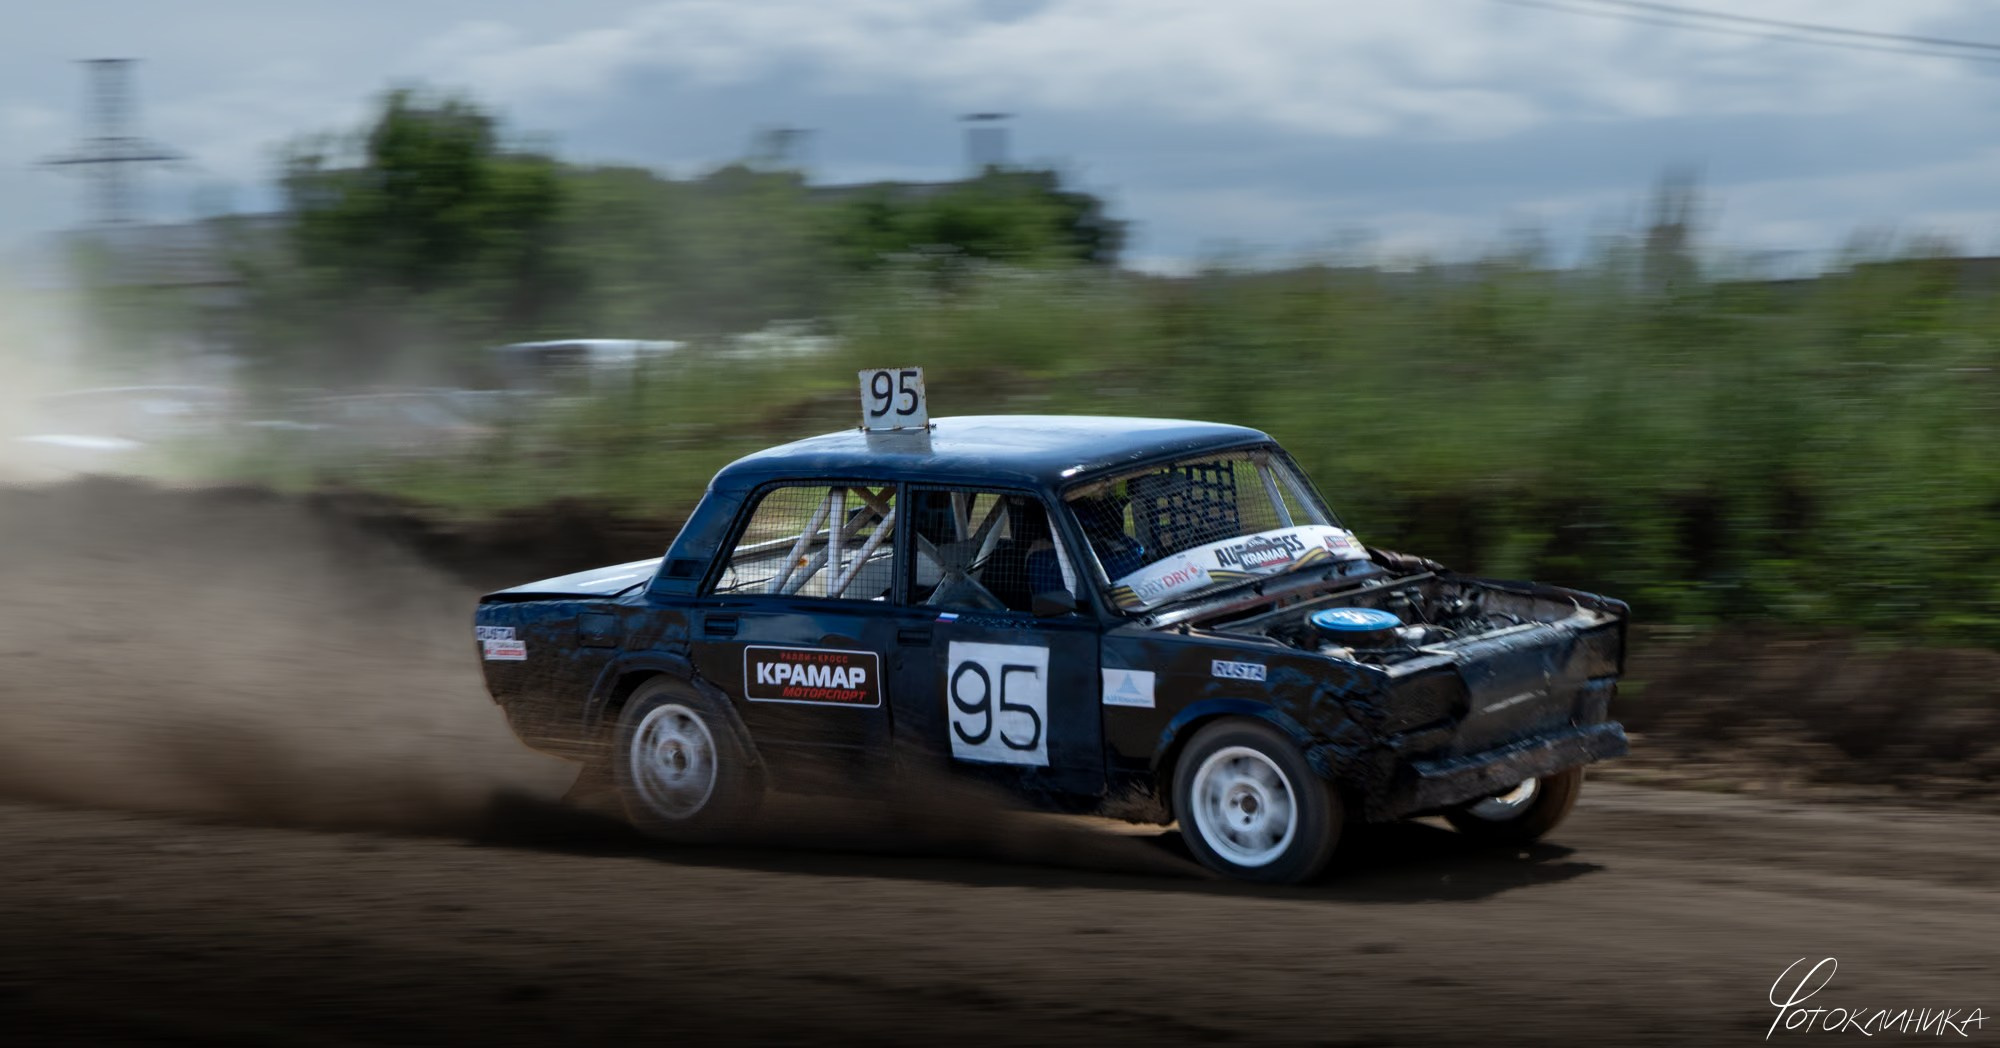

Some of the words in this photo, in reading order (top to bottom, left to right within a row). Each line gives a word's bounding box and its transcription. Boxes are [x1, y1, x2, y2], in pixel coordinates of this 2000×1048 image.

[870, 371, 919, 417] 95
[1240, 546, 1290, 568] KRAMAR
[756, 661, 866, 690] КРАМАР
[1215, 662, 1264, 679] RUSTA
[782, 686, 867, 702] МОТОРСПОРТ
[950, 660, 1042, 751] 95
